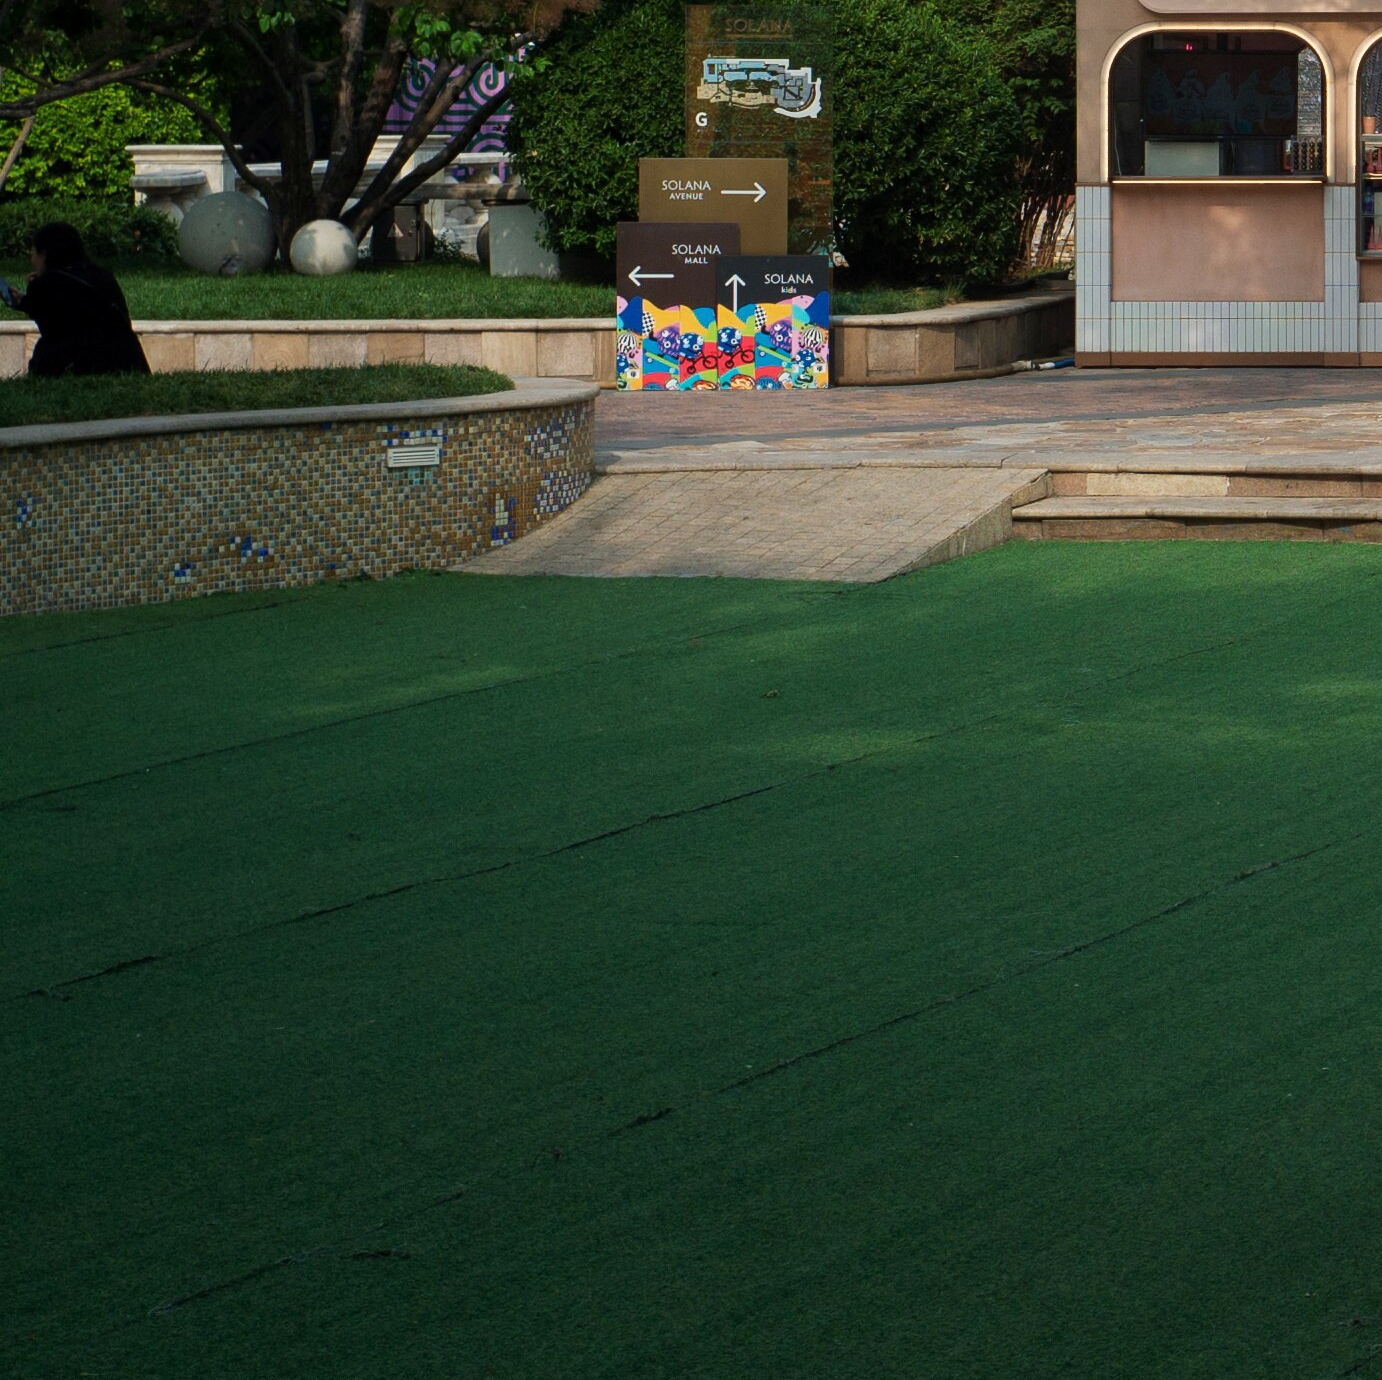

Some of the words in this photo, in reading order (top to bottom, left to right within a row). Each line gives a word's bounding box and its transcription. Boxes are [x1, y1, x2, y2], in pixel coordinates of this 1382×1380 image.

[695, 112, 708, 127] G
[662, 180, 712, 191] SOLANA
[672, 244, 721, 255] SOLANA
[764, 274, 814, 285] SOLANA
[781, 286, 797, 294] kids
